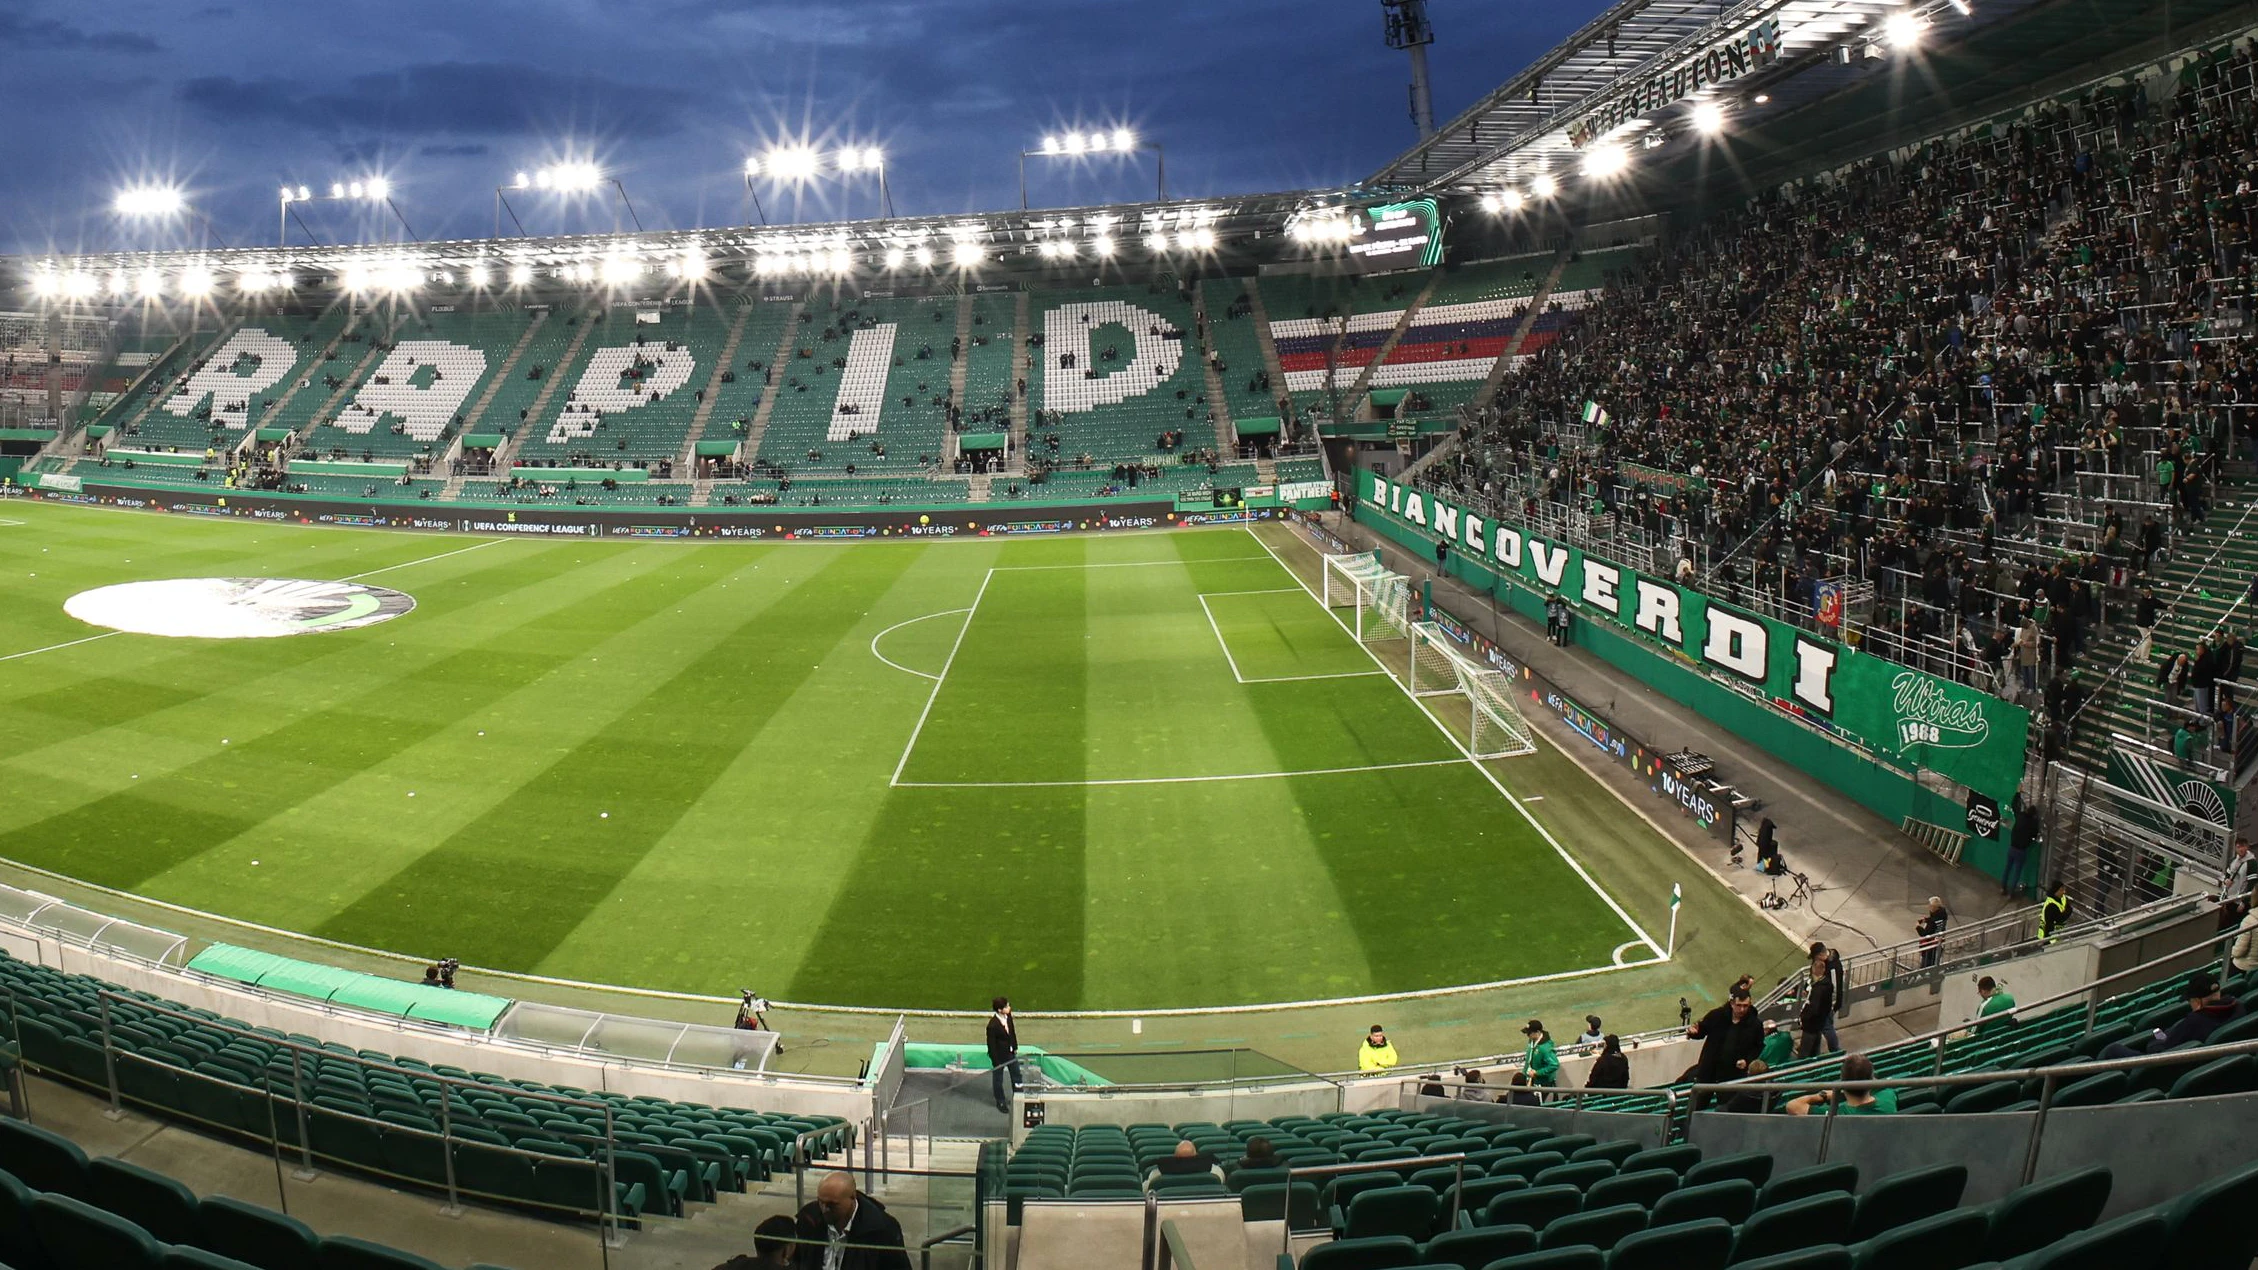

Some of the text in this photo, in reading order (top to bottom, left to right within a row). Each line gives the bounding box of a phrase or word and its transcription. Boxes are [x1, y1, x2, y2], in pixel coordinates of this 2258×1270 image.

[473, 522, 585, 534] UEFA CONFERENCE LEAGUE
[1547, 692, 1563, 712] UEFA
[1891, 672, 1985, 730] Ultras
